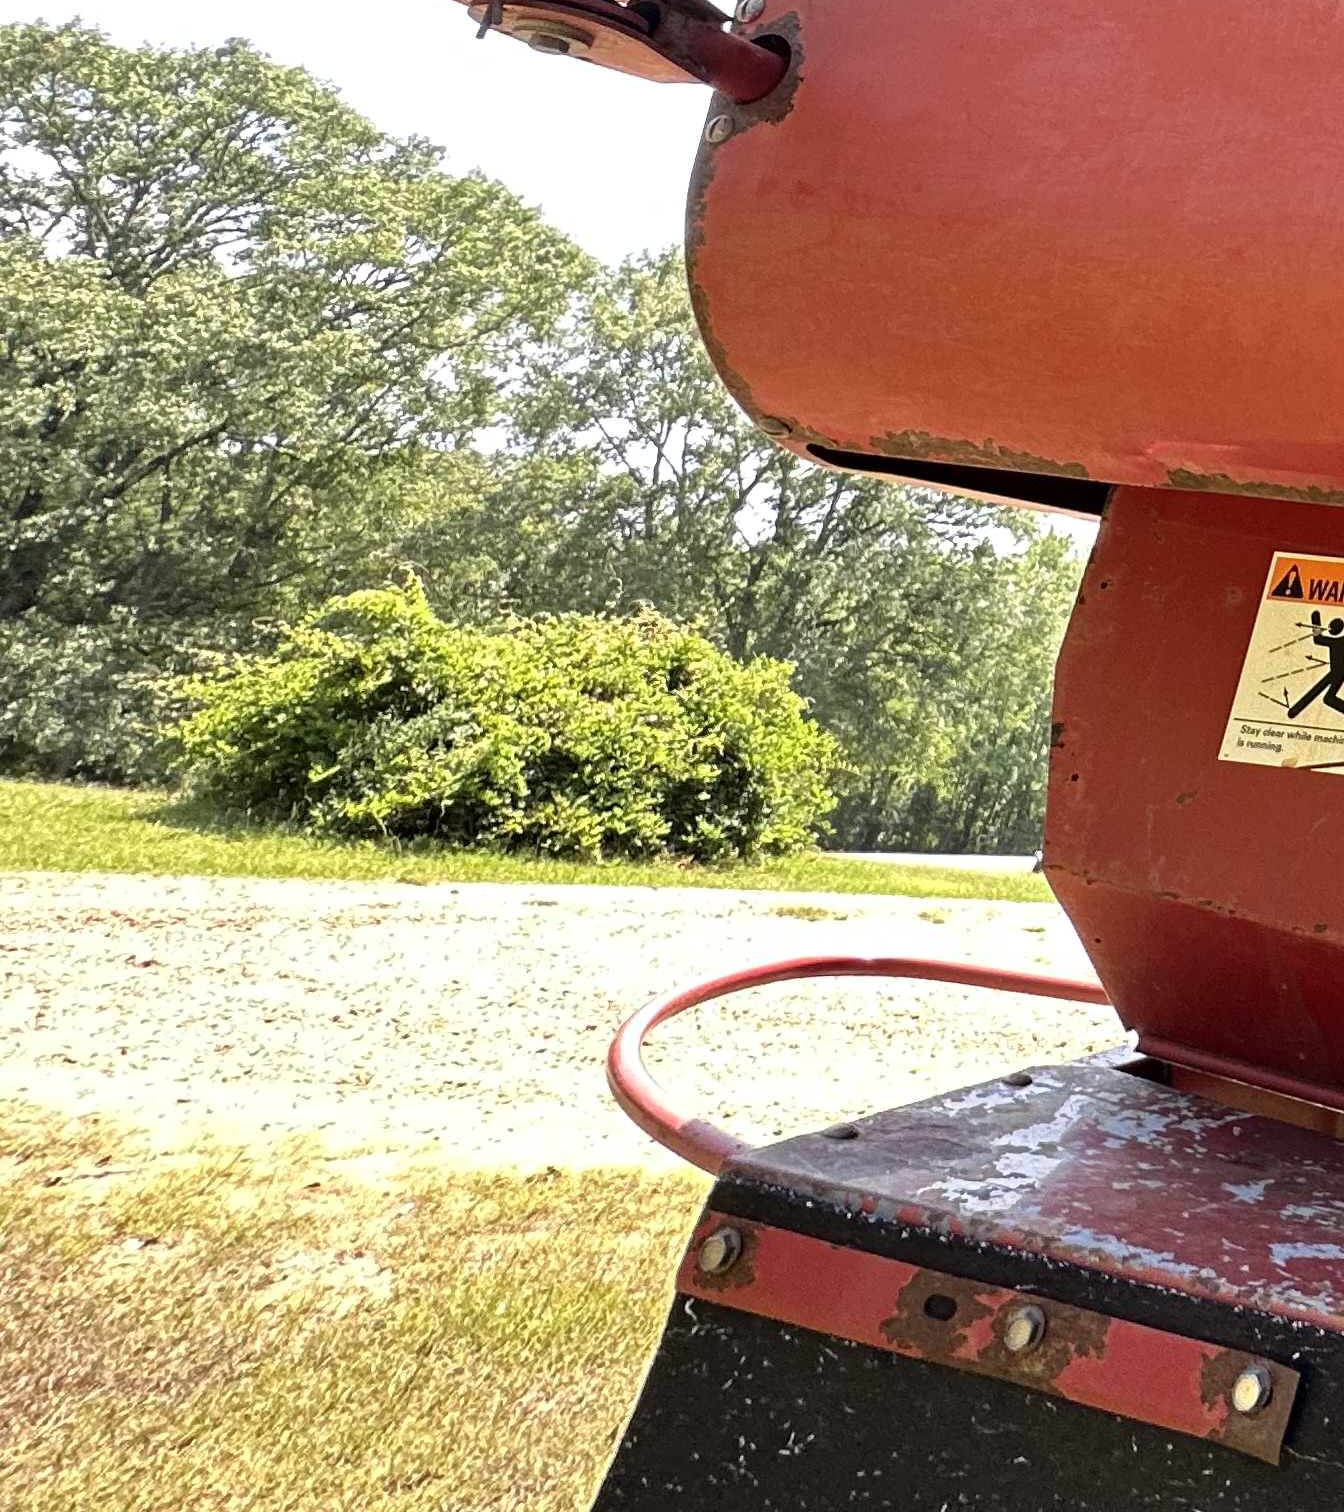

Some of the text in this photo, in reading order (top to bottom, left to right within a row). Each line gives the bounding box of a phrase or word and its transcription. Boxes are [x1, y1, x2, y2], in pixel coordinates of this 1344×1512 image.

[1240, 724, 1261, 737] Stay
[1262, 727, 1285, 738] clear
[1287, 729, 1312, 741] while
[1236, 737, 1284, 753] is running.
